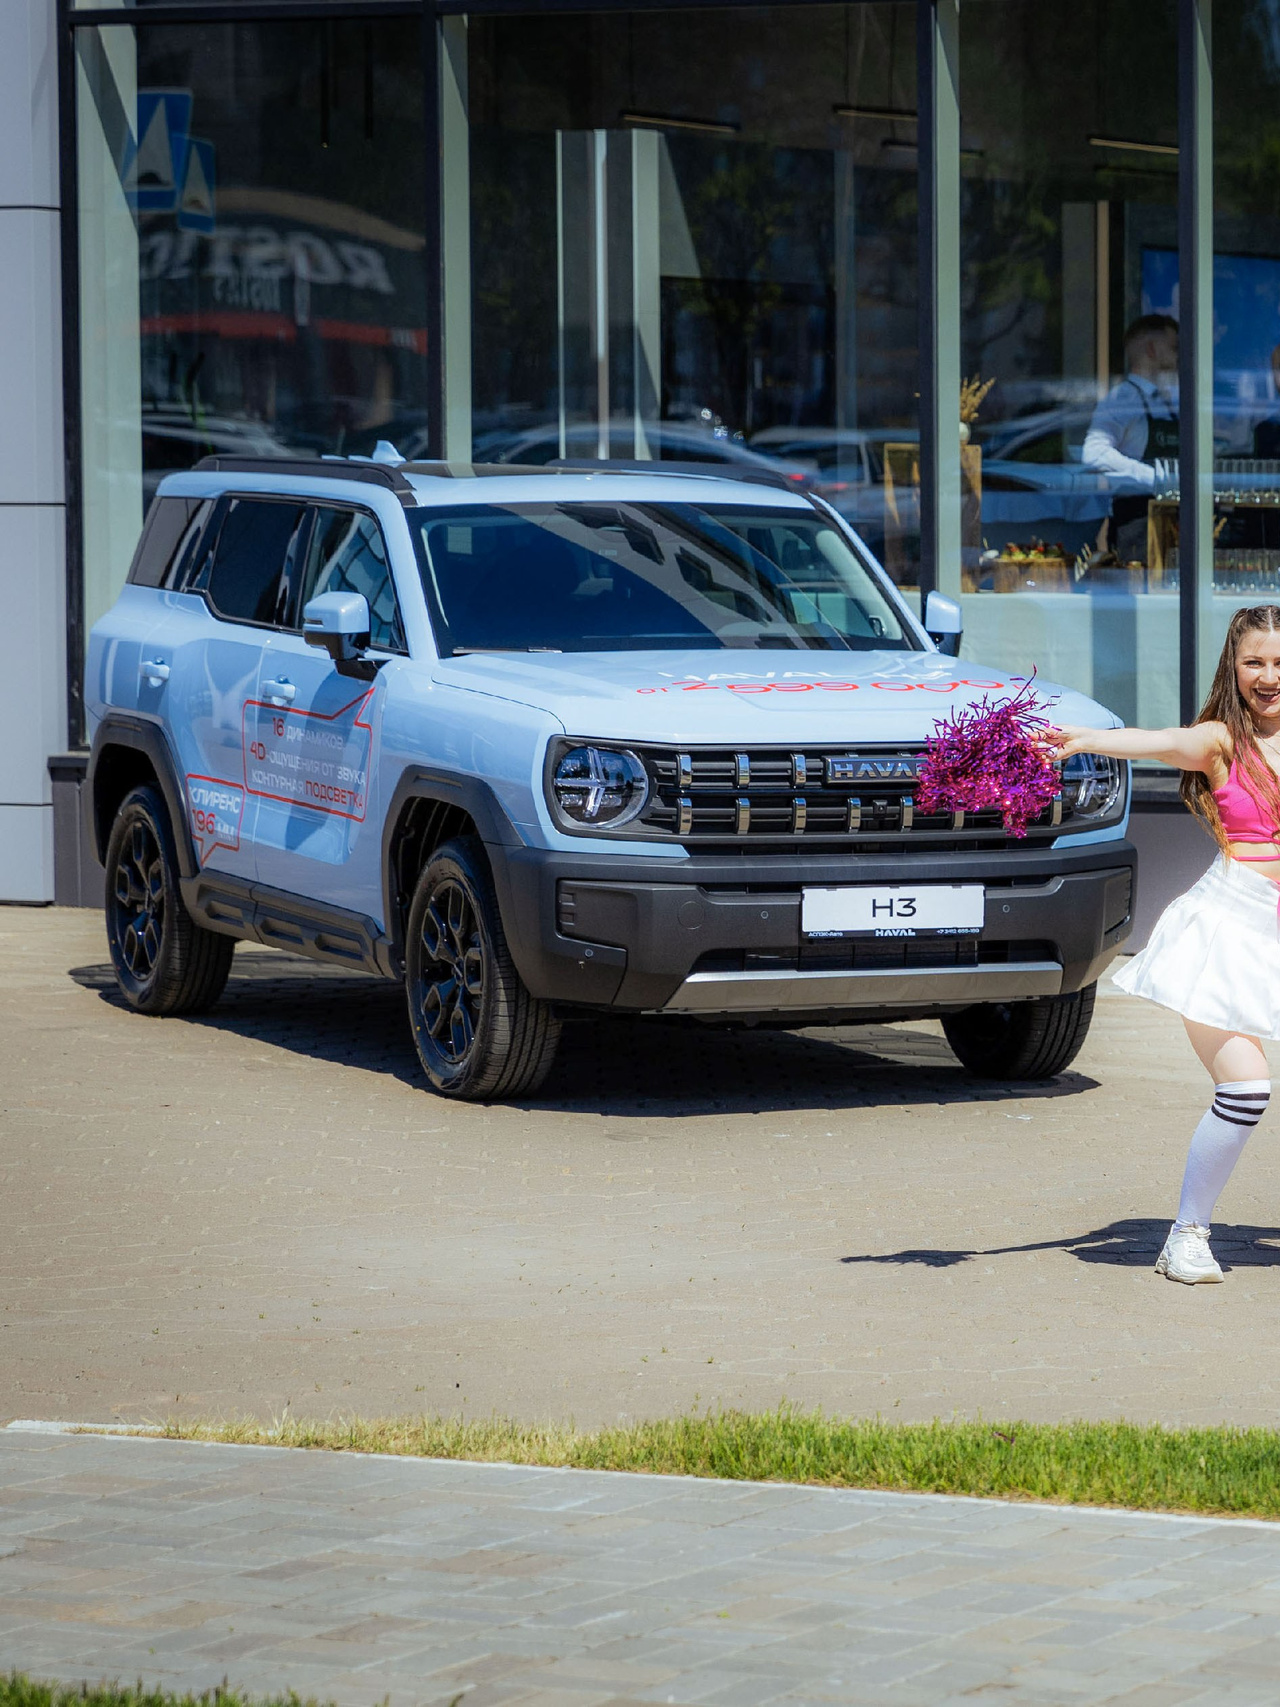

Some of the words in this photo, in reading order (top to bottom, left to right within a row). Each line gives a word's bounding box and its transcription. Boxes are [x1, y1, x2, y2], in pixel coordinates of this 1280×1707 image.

[672, 680, 720, 691] 2
[726, 681, 860, 694] 599
[272, 717, 285, 737] 16
[321, 762, 335, 777] ОТ
[336, 766, 366, 787] ЗВУКА
[189, 786, 241, 814] КЛИРЕНС
[251, 769, 305, 795] КОНТУРНАЯ
[305, 780, 364, 809] ПОДСВЕТКА
[192, 807, 216, 835] 196
[872, 898, 917, 918] H3
[875, 928, 917, 937] HAVAL
